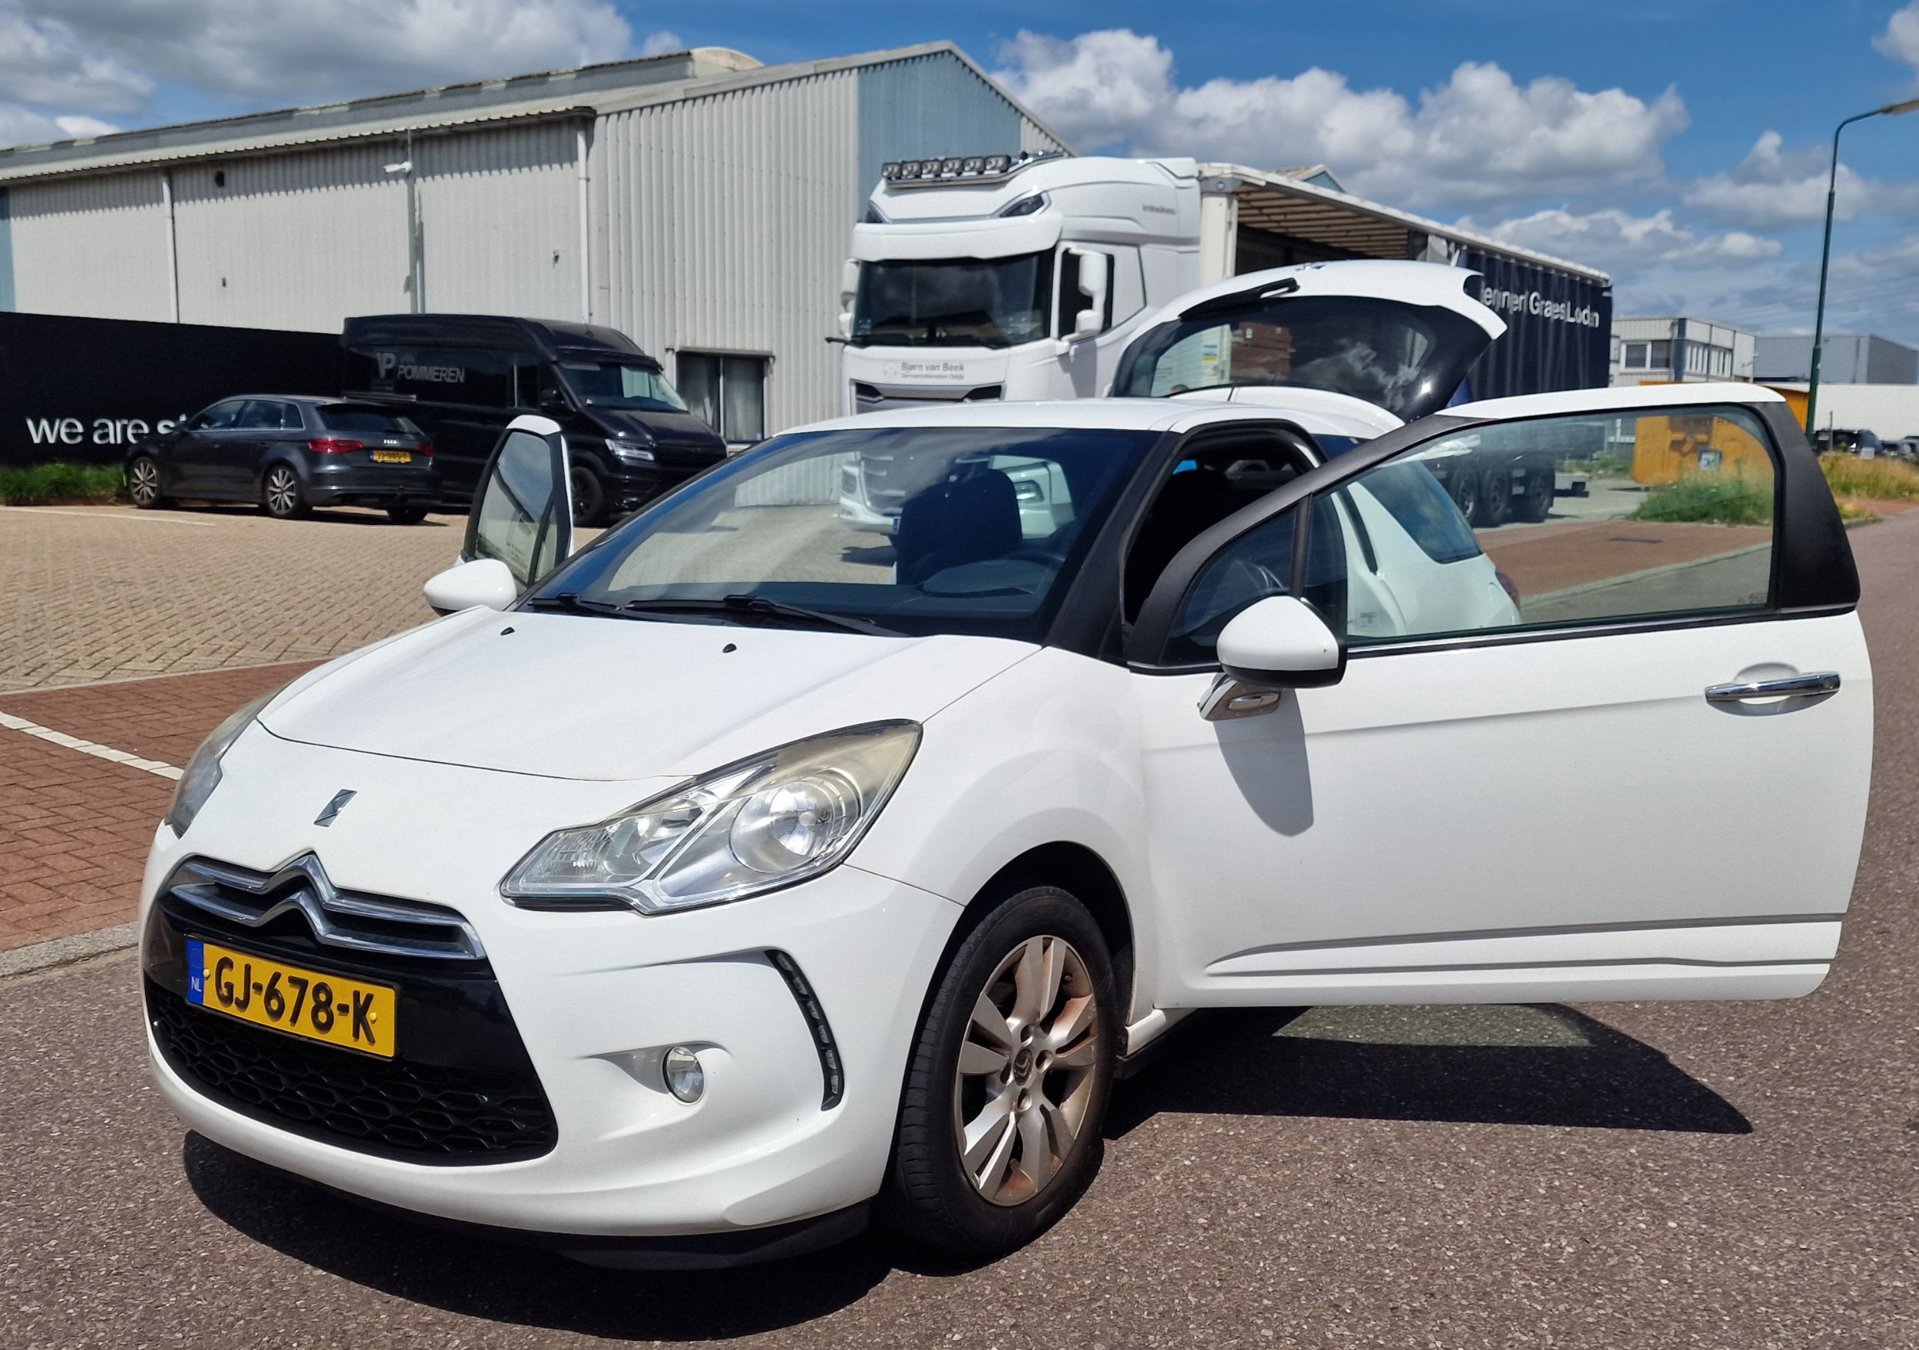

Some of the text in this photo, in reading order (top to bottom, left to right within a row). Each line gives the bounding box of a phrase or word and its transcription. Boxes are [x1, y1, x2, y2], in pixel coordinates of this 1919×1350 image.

[26, 417, 84, 445] we
[92, 418, 149, 445] are
[191, 975, 202, 993] NL
[214, 955, 377, 1045] GJ-678-K
